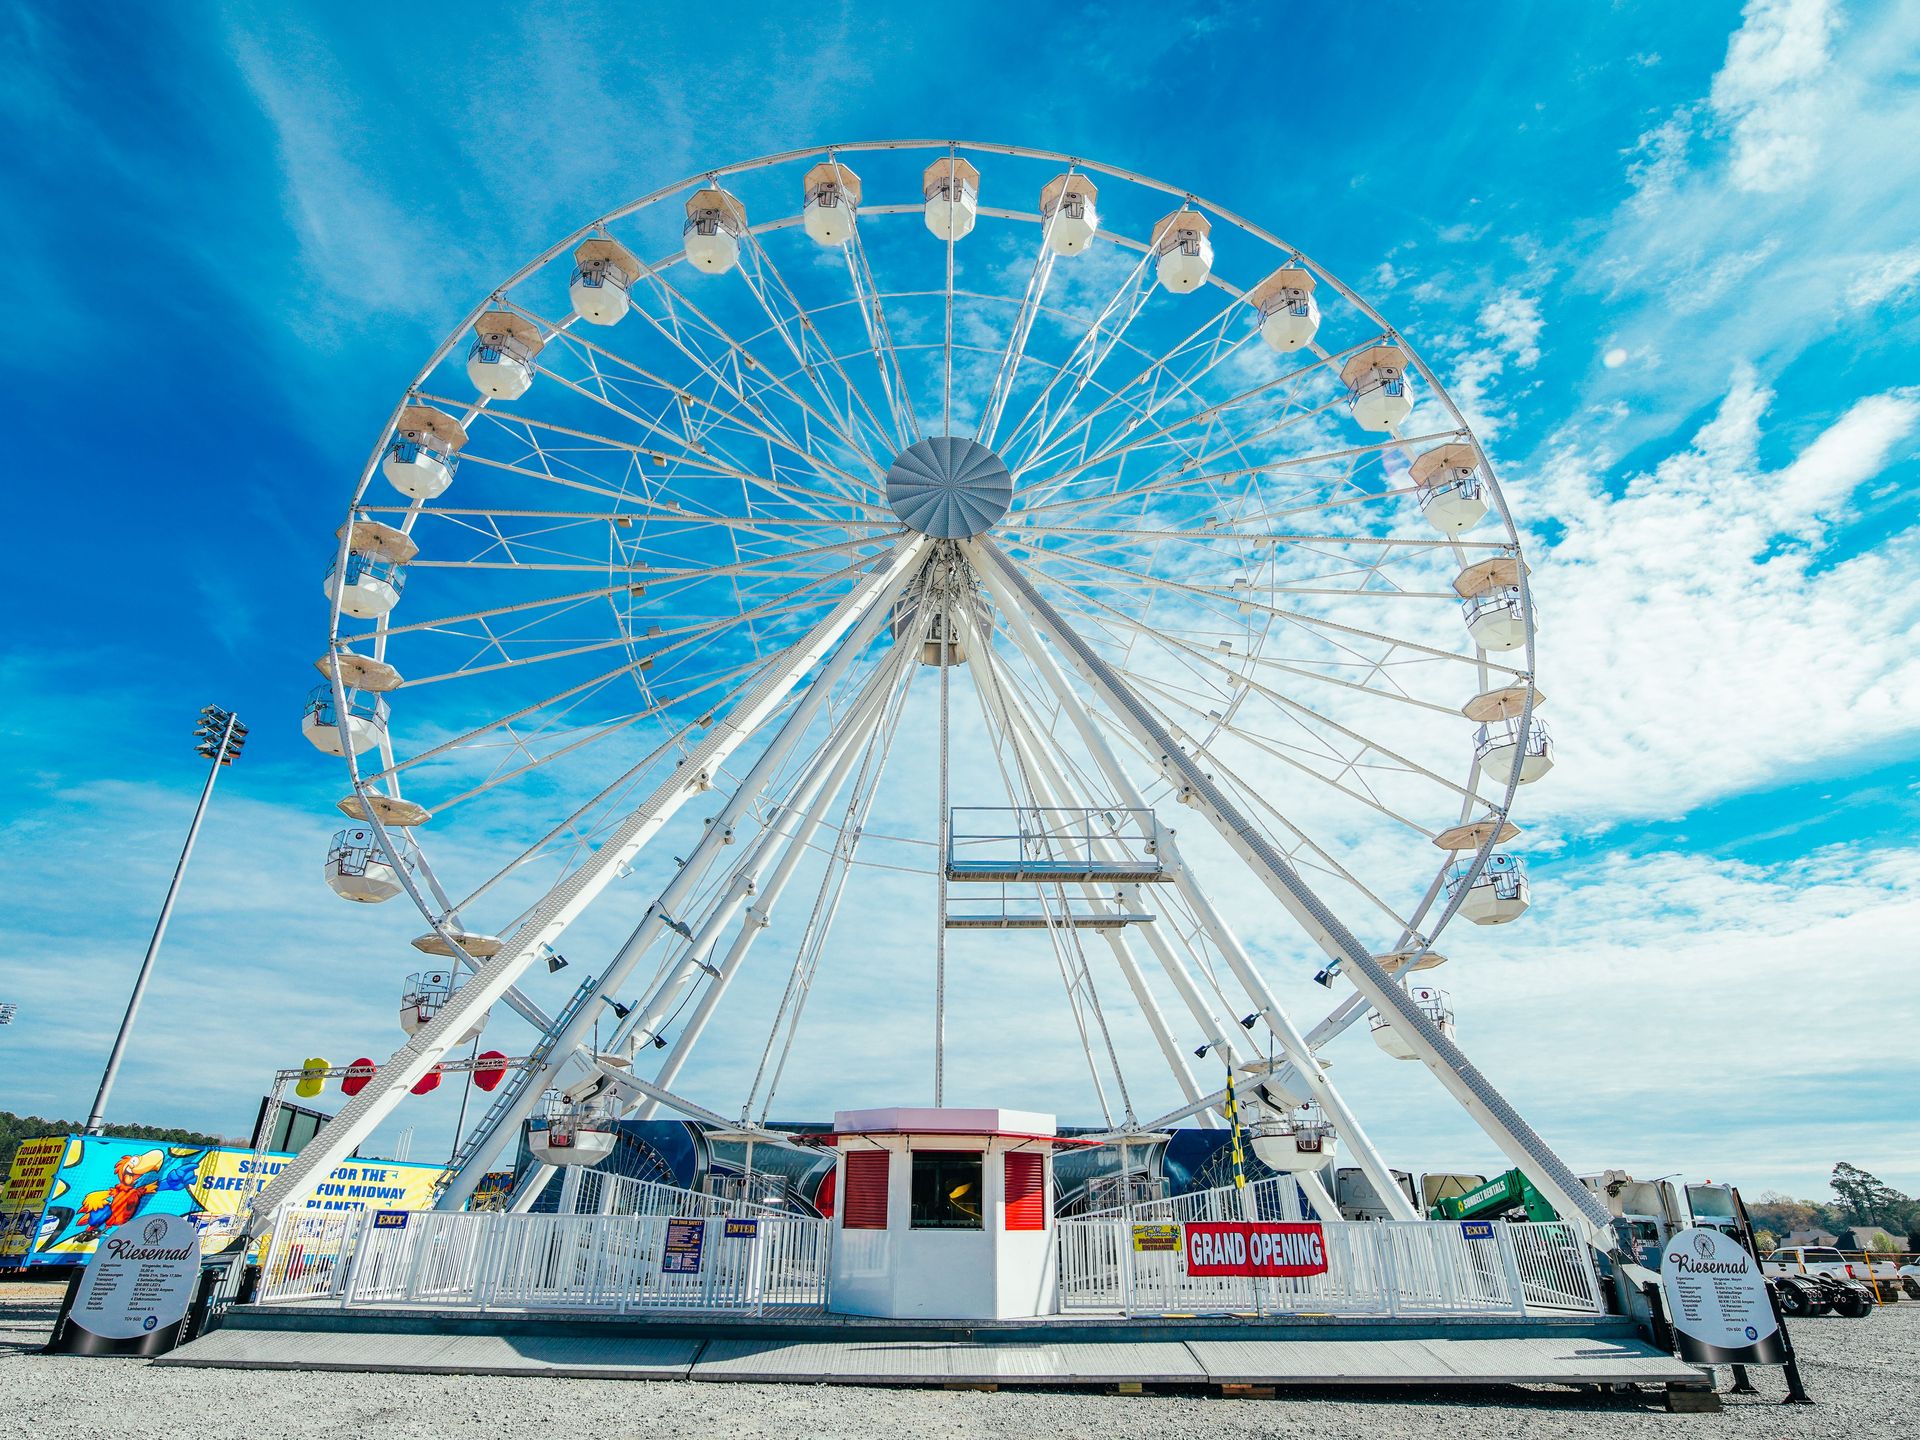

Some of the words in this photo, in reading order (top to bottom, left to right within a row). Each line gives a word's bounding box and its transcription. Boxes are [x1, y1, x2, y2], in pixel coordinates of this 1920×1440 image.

[53, 1144, 62, 1153] TO
[16, 1157, 27, 1166] THE
[28, 1156, 58, 1166] CEANEST
[330, 1167, 358, 1180] FOR
[361, 1169, 386, 1183] THE
[36, 1178, 46, 1187] ON
[203, 1175, 266, 1192] SAFET
[316, 1184, 346, 1196] FUN
[347, 1186, 406, 1199] MIDWAY
[7, 1190, 18, 1199] THE
[18, 1190, 43, 1199] PANET!
[1482, 1180, 1506, 1200] RENTALS
[377, 1214, 404, 1225] EXIT
[727, 1223, 755, 1233] ENTER
[1465, 1226, 1489, 1235] EXIT
[107, 1239, 194, 1260] Riesenrad
[1190, 1232, 1247, 1266] GRAND
[1249, 1232, 1323, 1266] OPENING
[1669, 1253, 1749, 1274] Riesenrad
